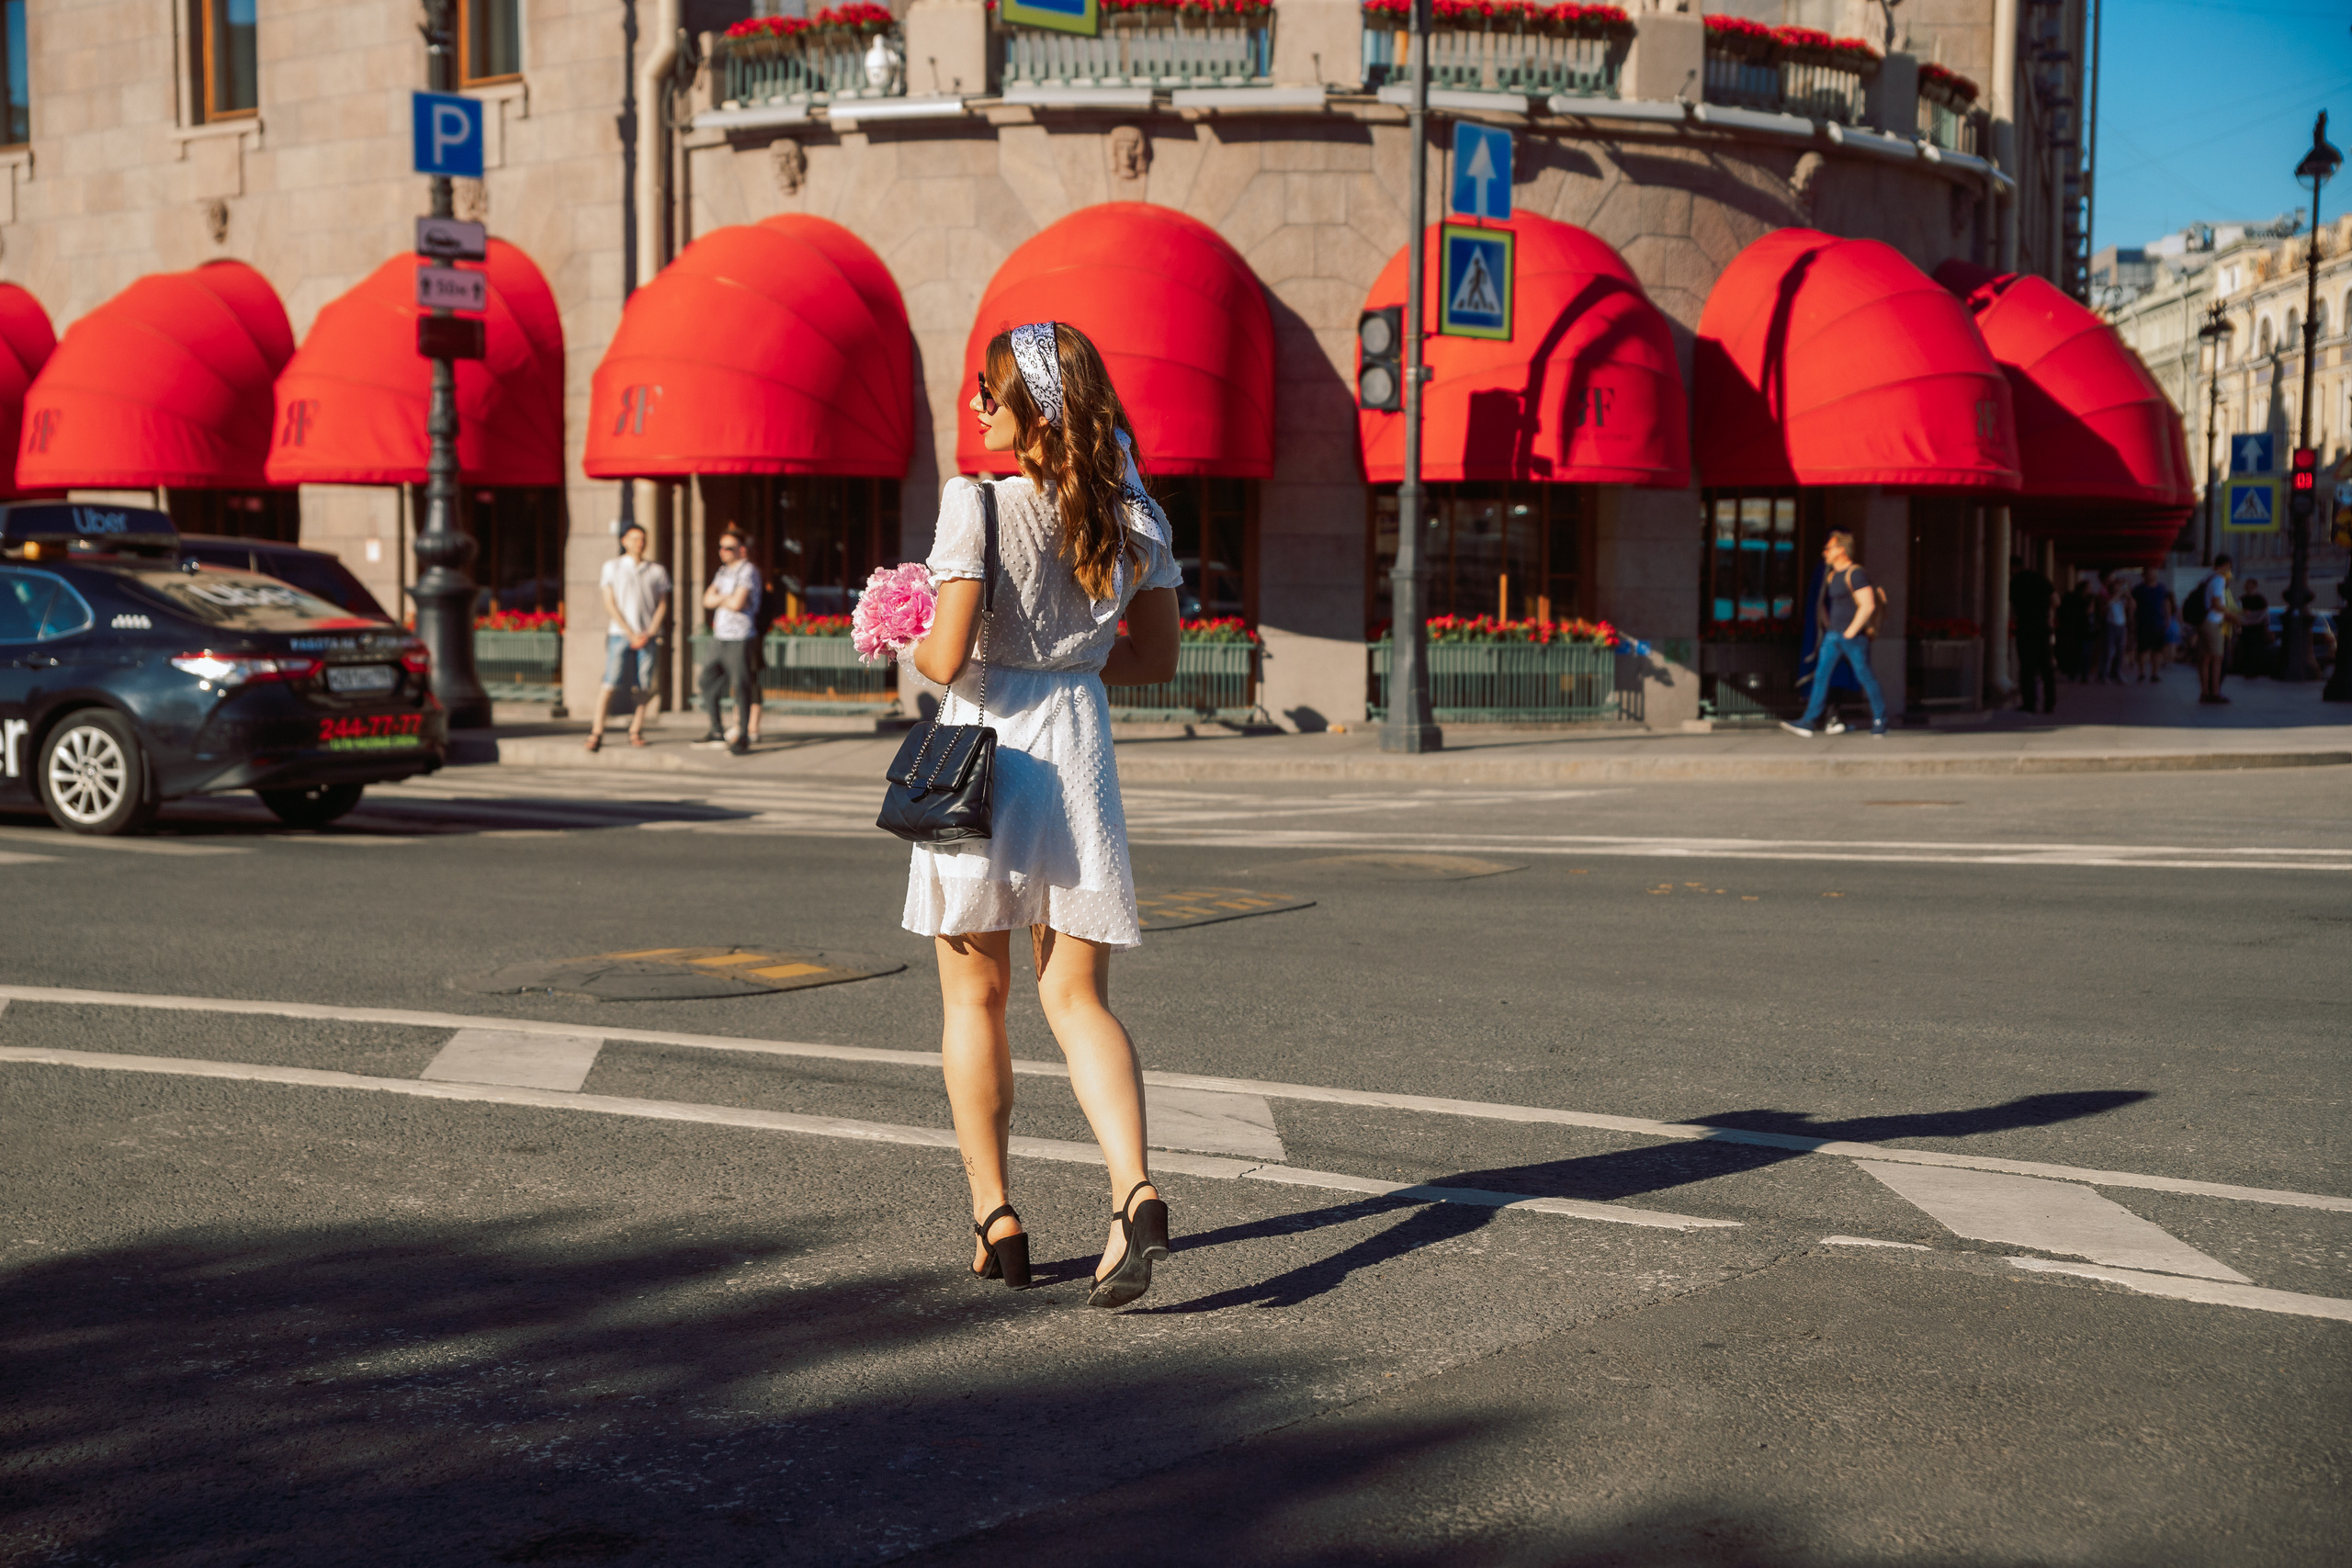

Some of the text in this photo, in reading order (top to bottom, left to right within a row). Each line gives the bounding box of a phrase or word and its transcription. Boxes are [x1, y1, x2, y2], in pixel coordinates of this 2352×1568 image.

[433, 104, 471, 165] P
[73, 506, 127, 534] Uber
[0, 718, 28, 778] r
